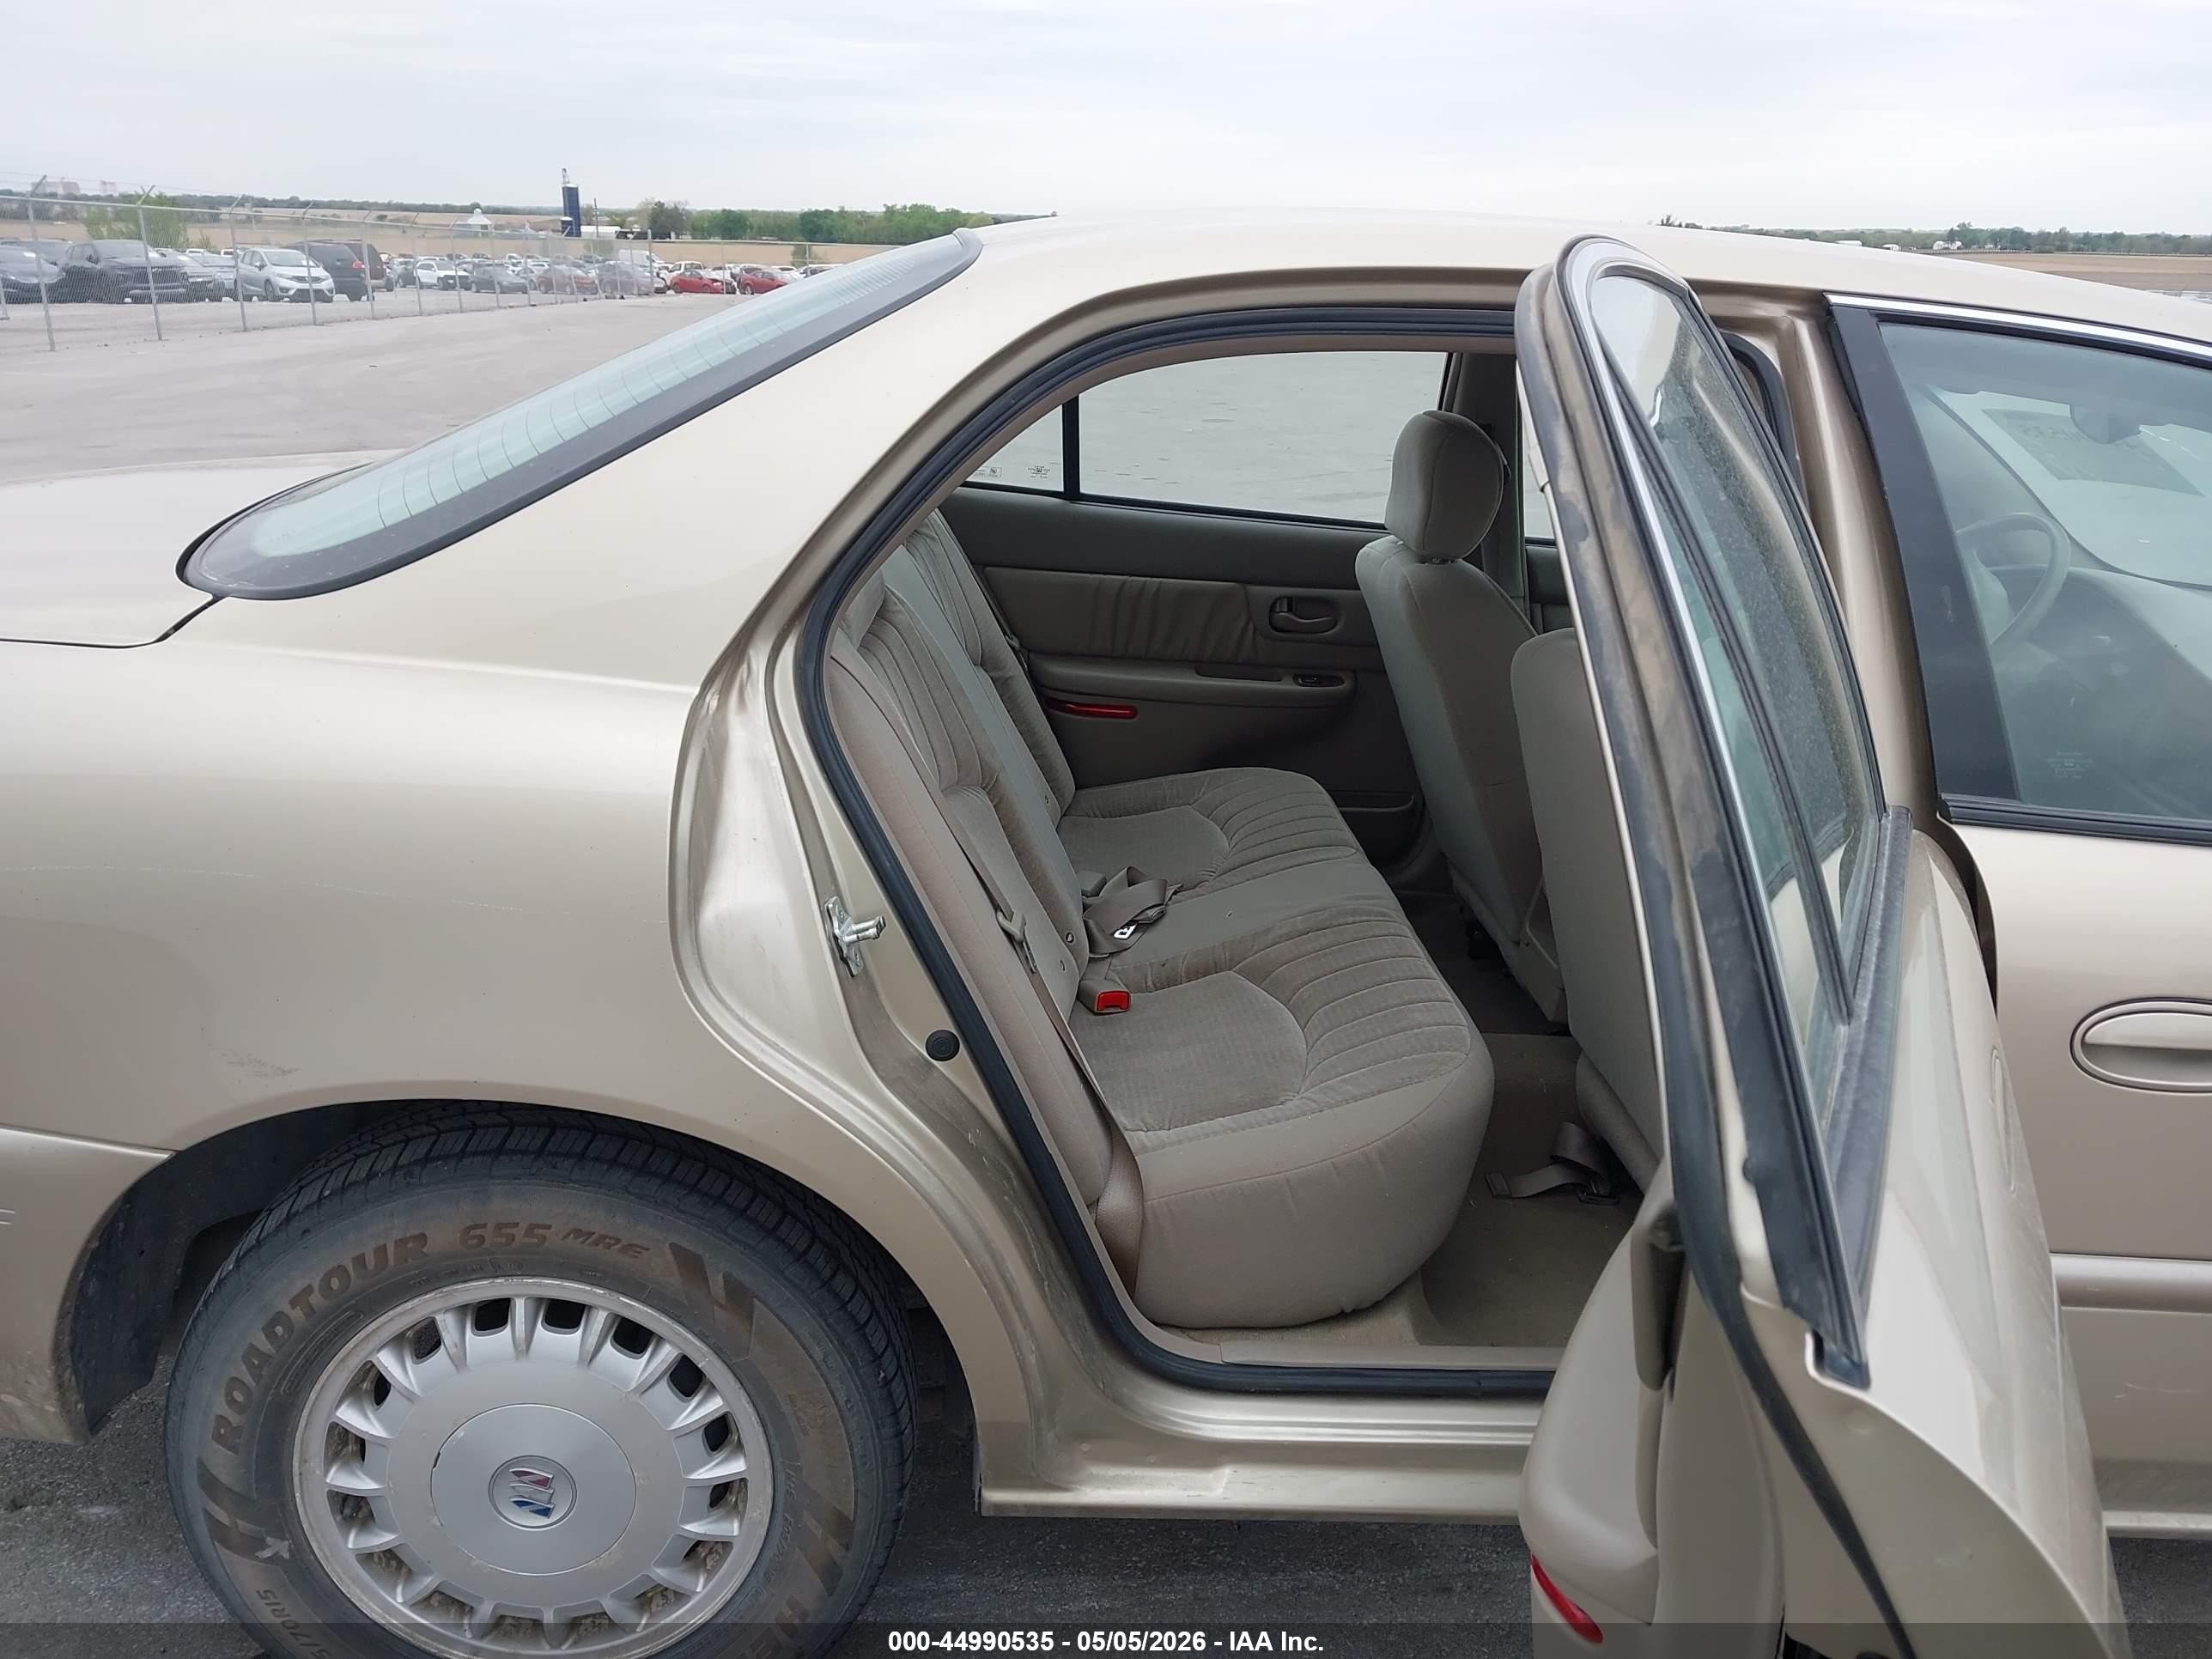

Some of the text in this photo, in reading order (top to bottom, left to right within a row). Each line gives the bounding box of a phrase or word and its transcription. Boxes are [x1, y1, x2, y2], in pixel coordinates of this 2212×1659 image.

[211, 1231, 430, 1455] ROADTOUR
[459, 1222, 552, 1249] 655
[561, 1228, 652, 1259] MRE
